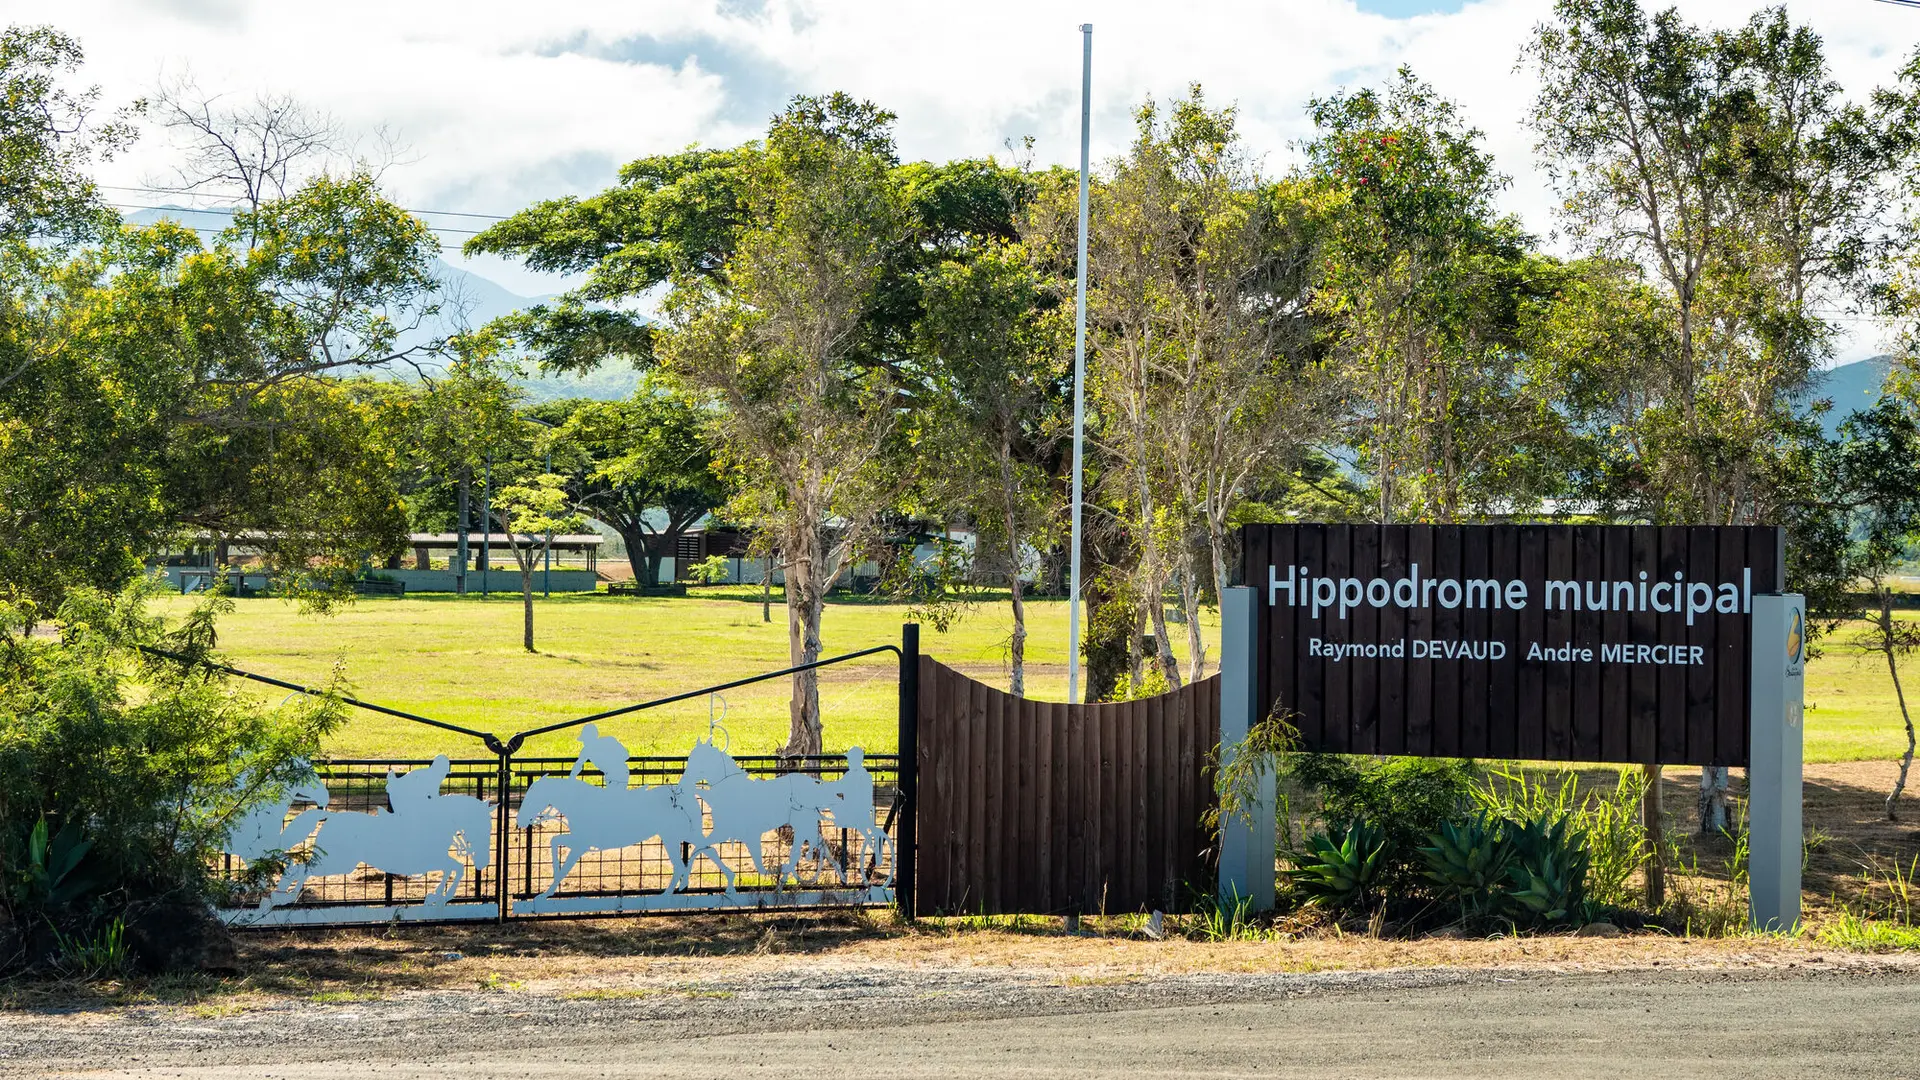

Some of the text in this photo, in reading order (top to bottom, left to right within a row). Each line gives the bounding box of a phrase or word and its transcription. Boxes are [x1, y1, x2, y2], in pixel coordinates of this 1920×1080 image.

[1268, 562, 1751, 626] Hippodrome municipal
[1308, 637, 1704, 665] Raymond DEVAUD Andre MERCIER
